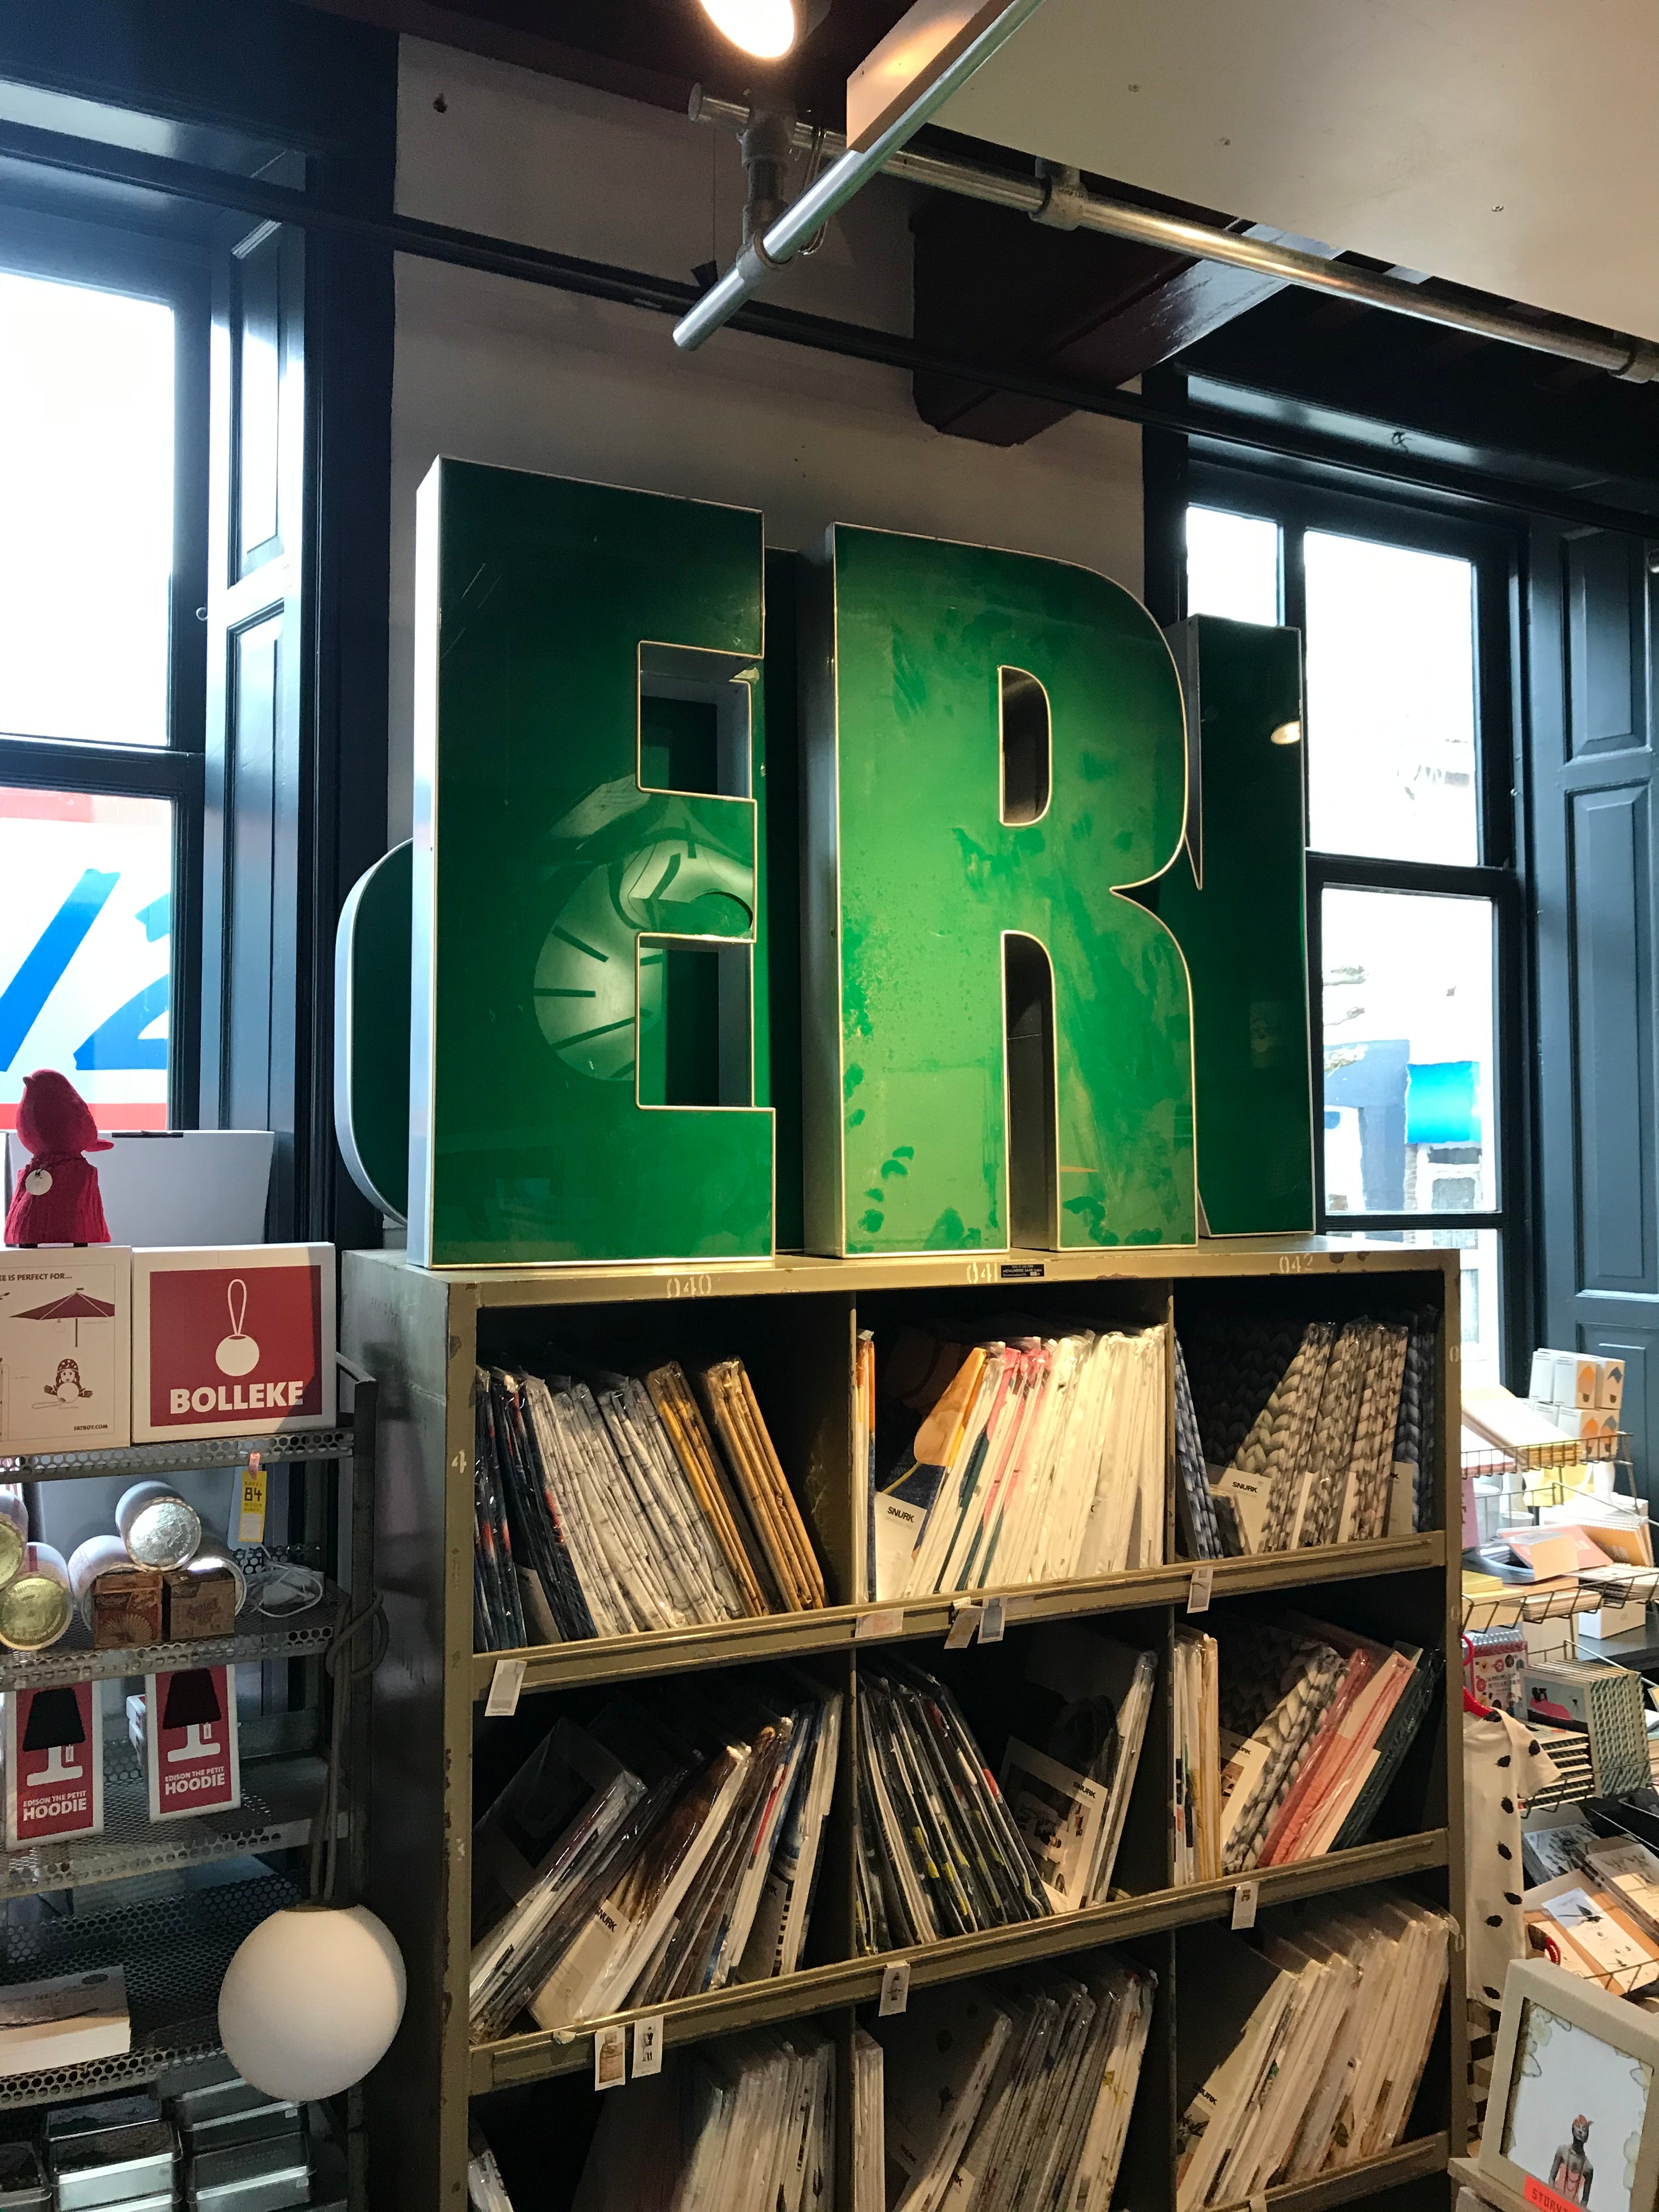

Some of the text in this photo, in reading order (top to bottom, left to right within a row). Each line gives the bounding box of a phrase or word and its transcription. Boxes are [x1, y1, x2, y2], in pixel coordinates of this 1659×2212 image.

[1279, 1253, 1313, 1273] 042
[666, 1274, 712, 1298] 040
[170, 1381, 303, 1414] BOLLEKE
[452, 1450, 467, 1474] 4
[244, 1487, 262, 1502] 84
[1232, 1481, 1258, 1493] SNURK
[887, 1506, 916, 1523] SNURK
[165, 1771, 191, 1782] EDISON
[206, 1766, 224, 1775] PETIT
[165, 1773, 225, 1795] HOODIE
[23, 1790, 87, 1807] EDISON THE PETIT
[23, 1798, 87, 1821] HOODIE
